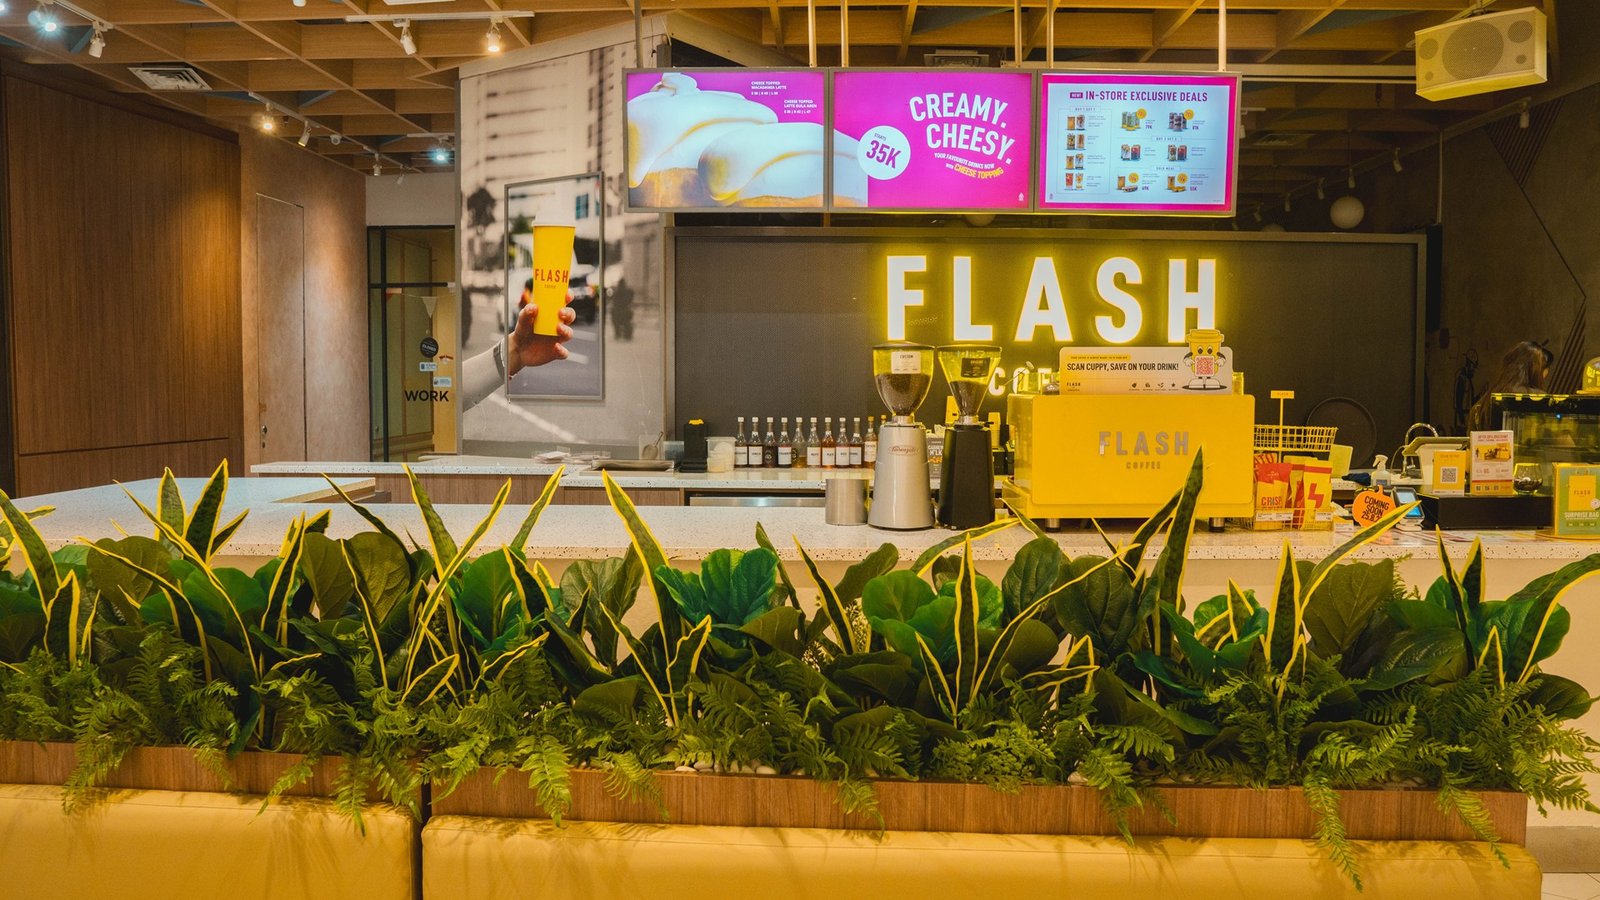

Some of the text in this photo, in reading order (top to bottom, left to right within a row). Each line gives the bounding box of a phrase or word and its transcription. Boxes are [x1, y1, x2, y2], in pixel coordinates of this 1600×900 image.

[1085, 91, 1127, 101] IN-STORE
[1131, 91, 1177, 101] EXCLUSIVE
[1180, 92, 1208, 102] DEALS
[909, 92, 1008, 128] CREAMY.
[926, 123, 1015, 165] CHEESY.
[866, 140, 902, 169] 35K
[954, 164, 977, 178] CHEESE
[977, 166, 1004, 179] TOPPING
[535, 268, 569, 283] FLASH
[886, 255, 1216, 344] FLASH
[1086, 363, 1109, 372] CUPPY,
[404, 390, 449, 402] WORK
[1099, 431, 1190, 456] FLASH
[1126, 461, 1161, 470] COFFEE
[1254, 453, 1274, 466] ATO
[1261, 496, 1282, 506] CRISP
[1364, 496, 1390, 510] COMING
[1366, 504, 1384, 516] SOON
